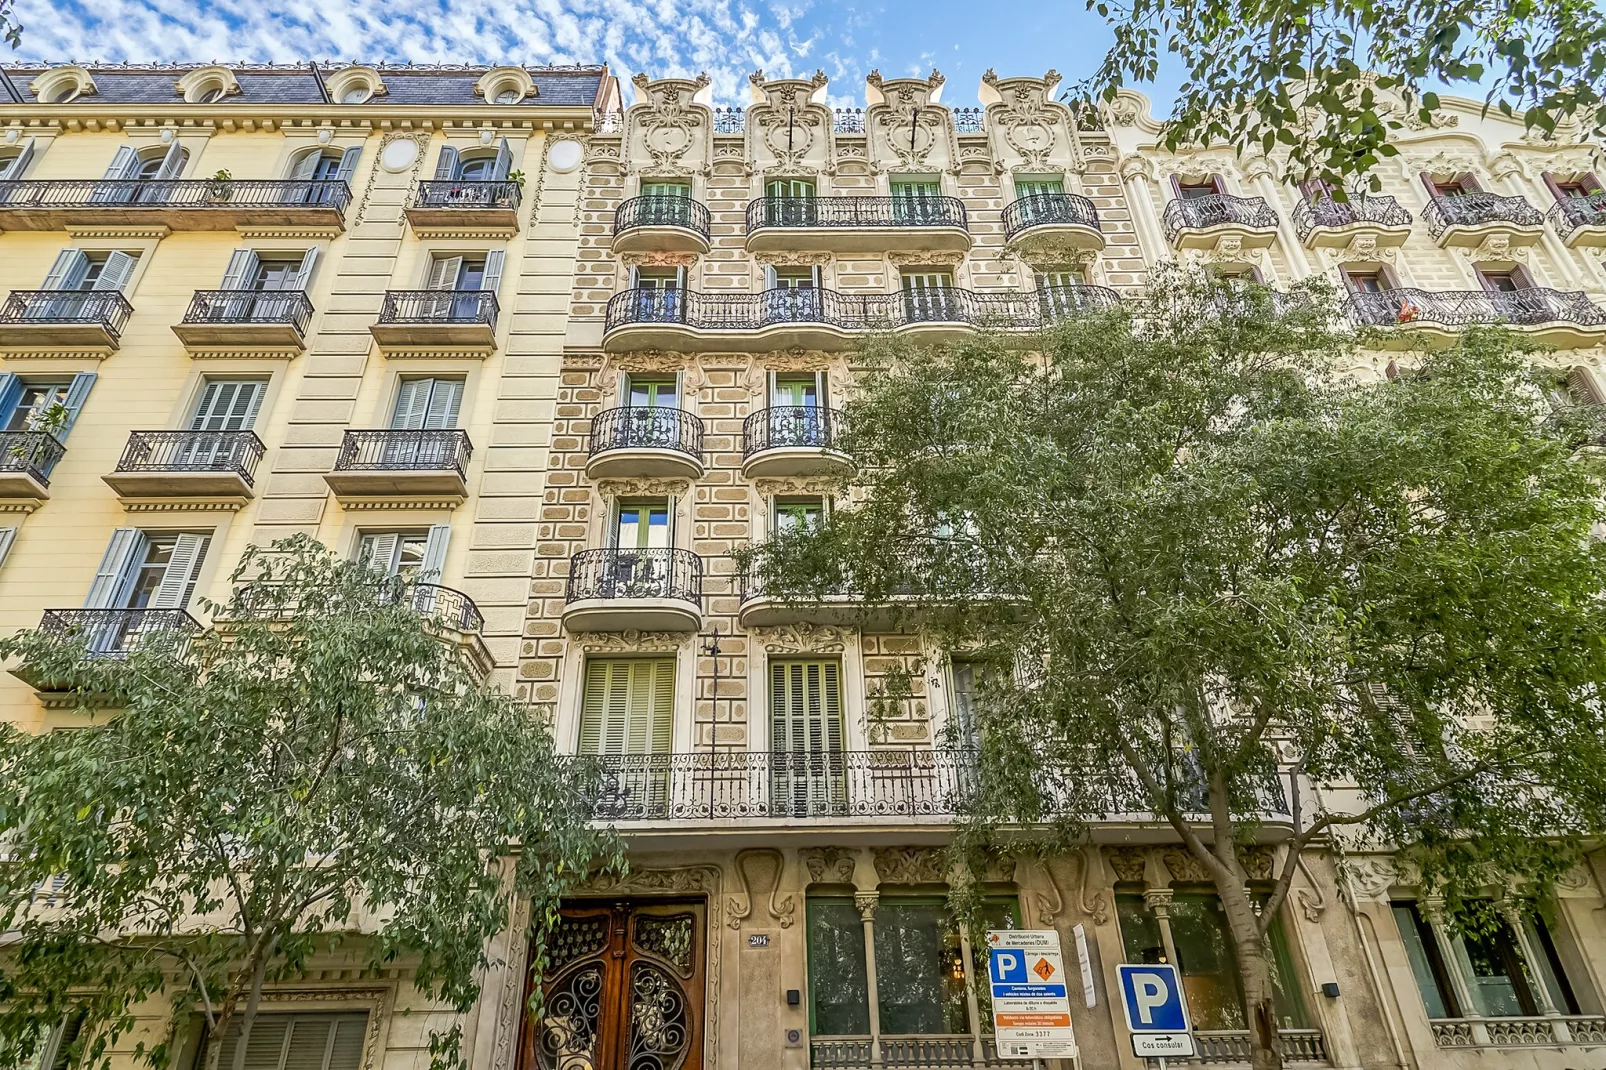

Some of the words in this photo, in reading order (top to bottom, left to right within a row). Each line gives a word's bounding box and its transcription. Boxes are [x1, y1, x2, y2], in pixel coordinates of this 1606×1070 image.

[751, 936, 767, 945] 204
[997, 954, 1018, 980] P
[1131, 973, 1169, 1024] P
[1142, 1041, 1155, 1049] Cos
[1156, 1041, 1184, 1049] consular
